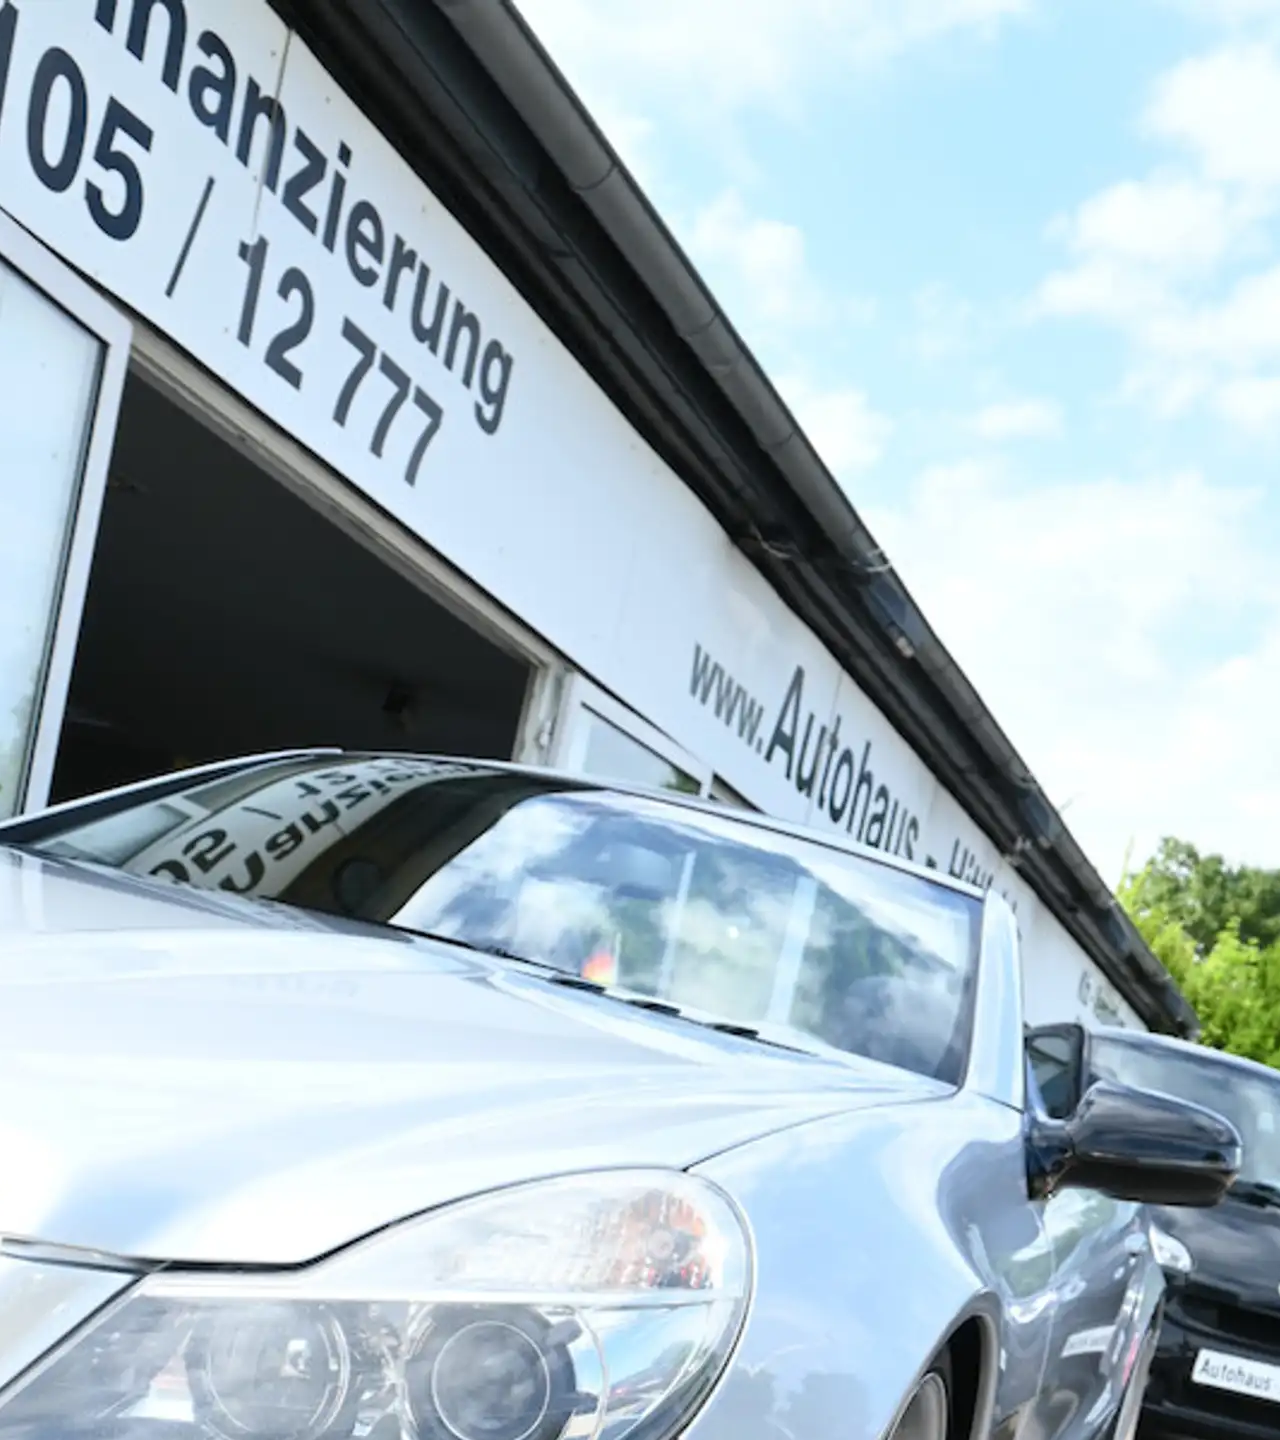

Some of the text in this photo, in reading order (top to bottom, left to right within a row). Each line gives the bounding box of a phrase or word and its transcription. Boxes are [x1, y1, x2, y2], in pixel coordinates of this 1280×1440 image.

[237, 235, 315, 392] 12
[332, 316, 443, 488] 777
[1199, 1358, 1271, 1392] Autohaus
